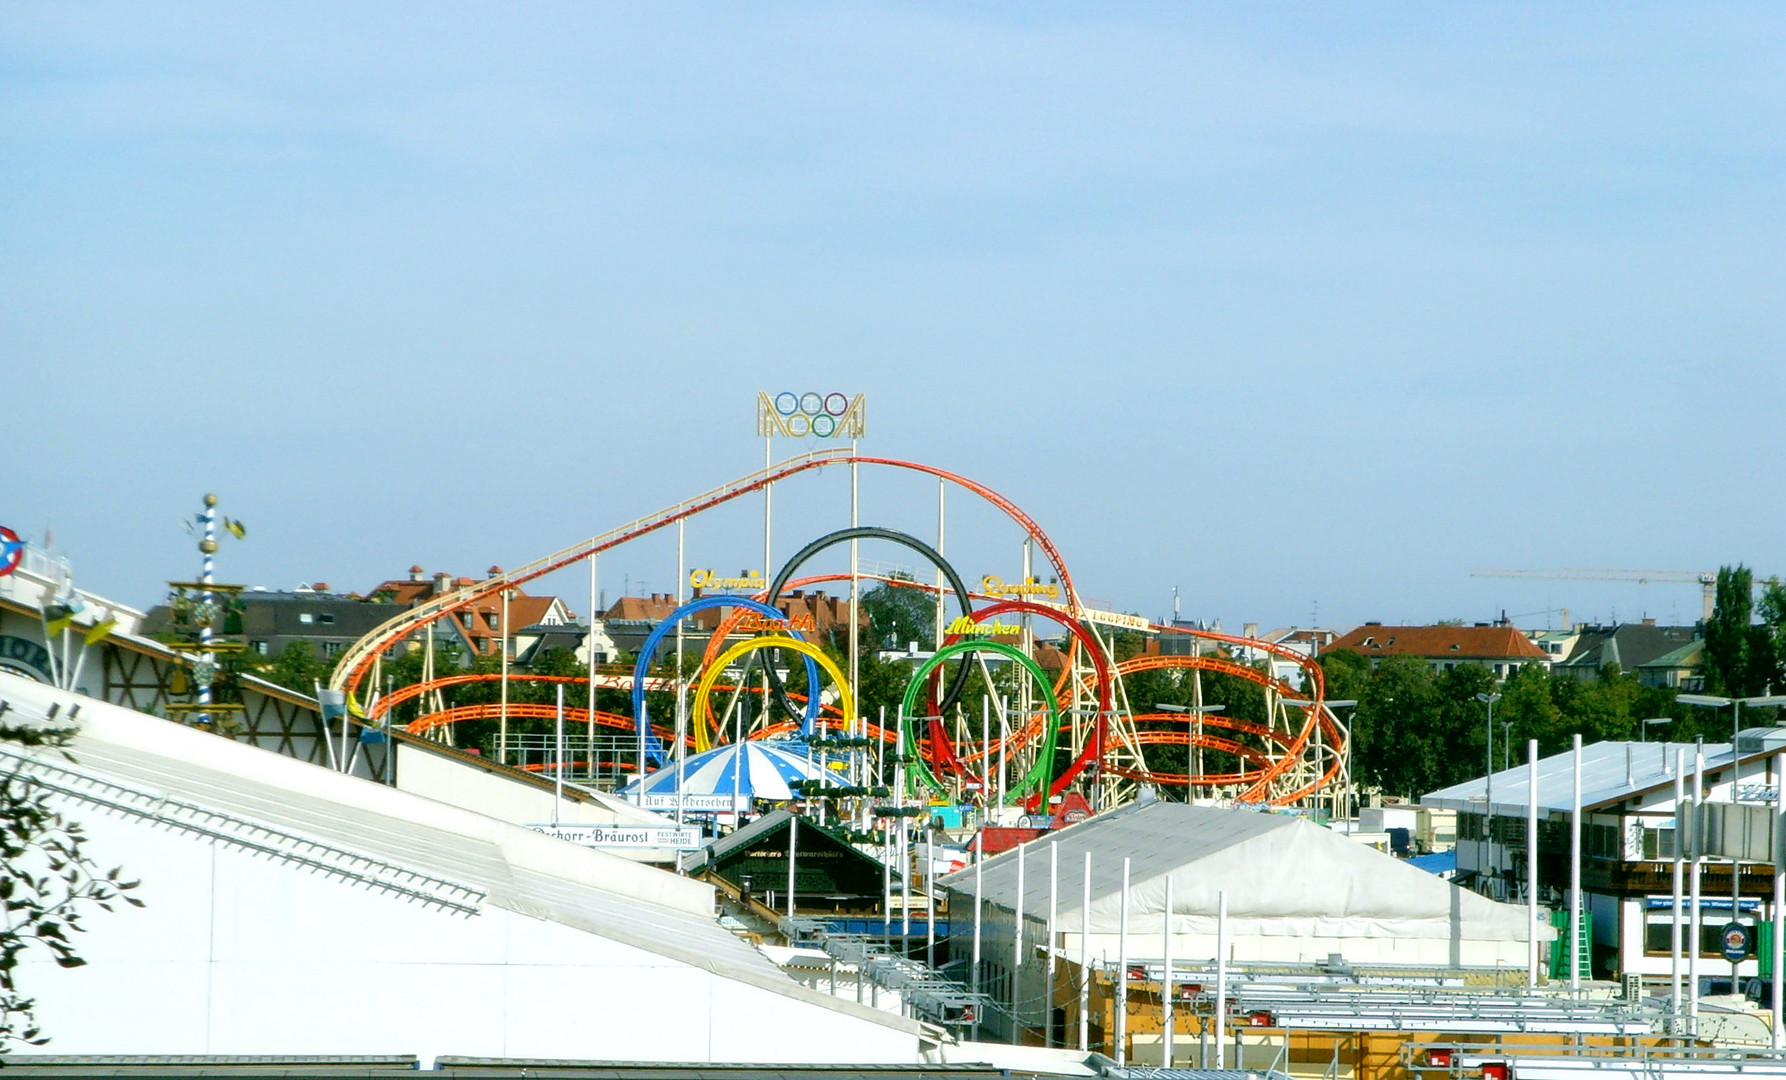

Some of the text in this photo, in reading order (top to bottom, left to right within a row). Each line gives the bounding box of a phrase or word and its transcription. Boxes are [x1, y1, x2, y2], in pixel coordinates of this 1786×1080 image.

[689, 569, 765, 590] Olympia
[982, 575, 1059, 599] Looping
[737, 612, 815, 632] Barth
[944, 616, 1022, 635] München
[1092, 610, 1143, 628] LOOPING
[596, 675, 674, 691] Bath
[645, 795, 664, 806] Auf
[533, 827, 648, 843] horr-Bräurosl
